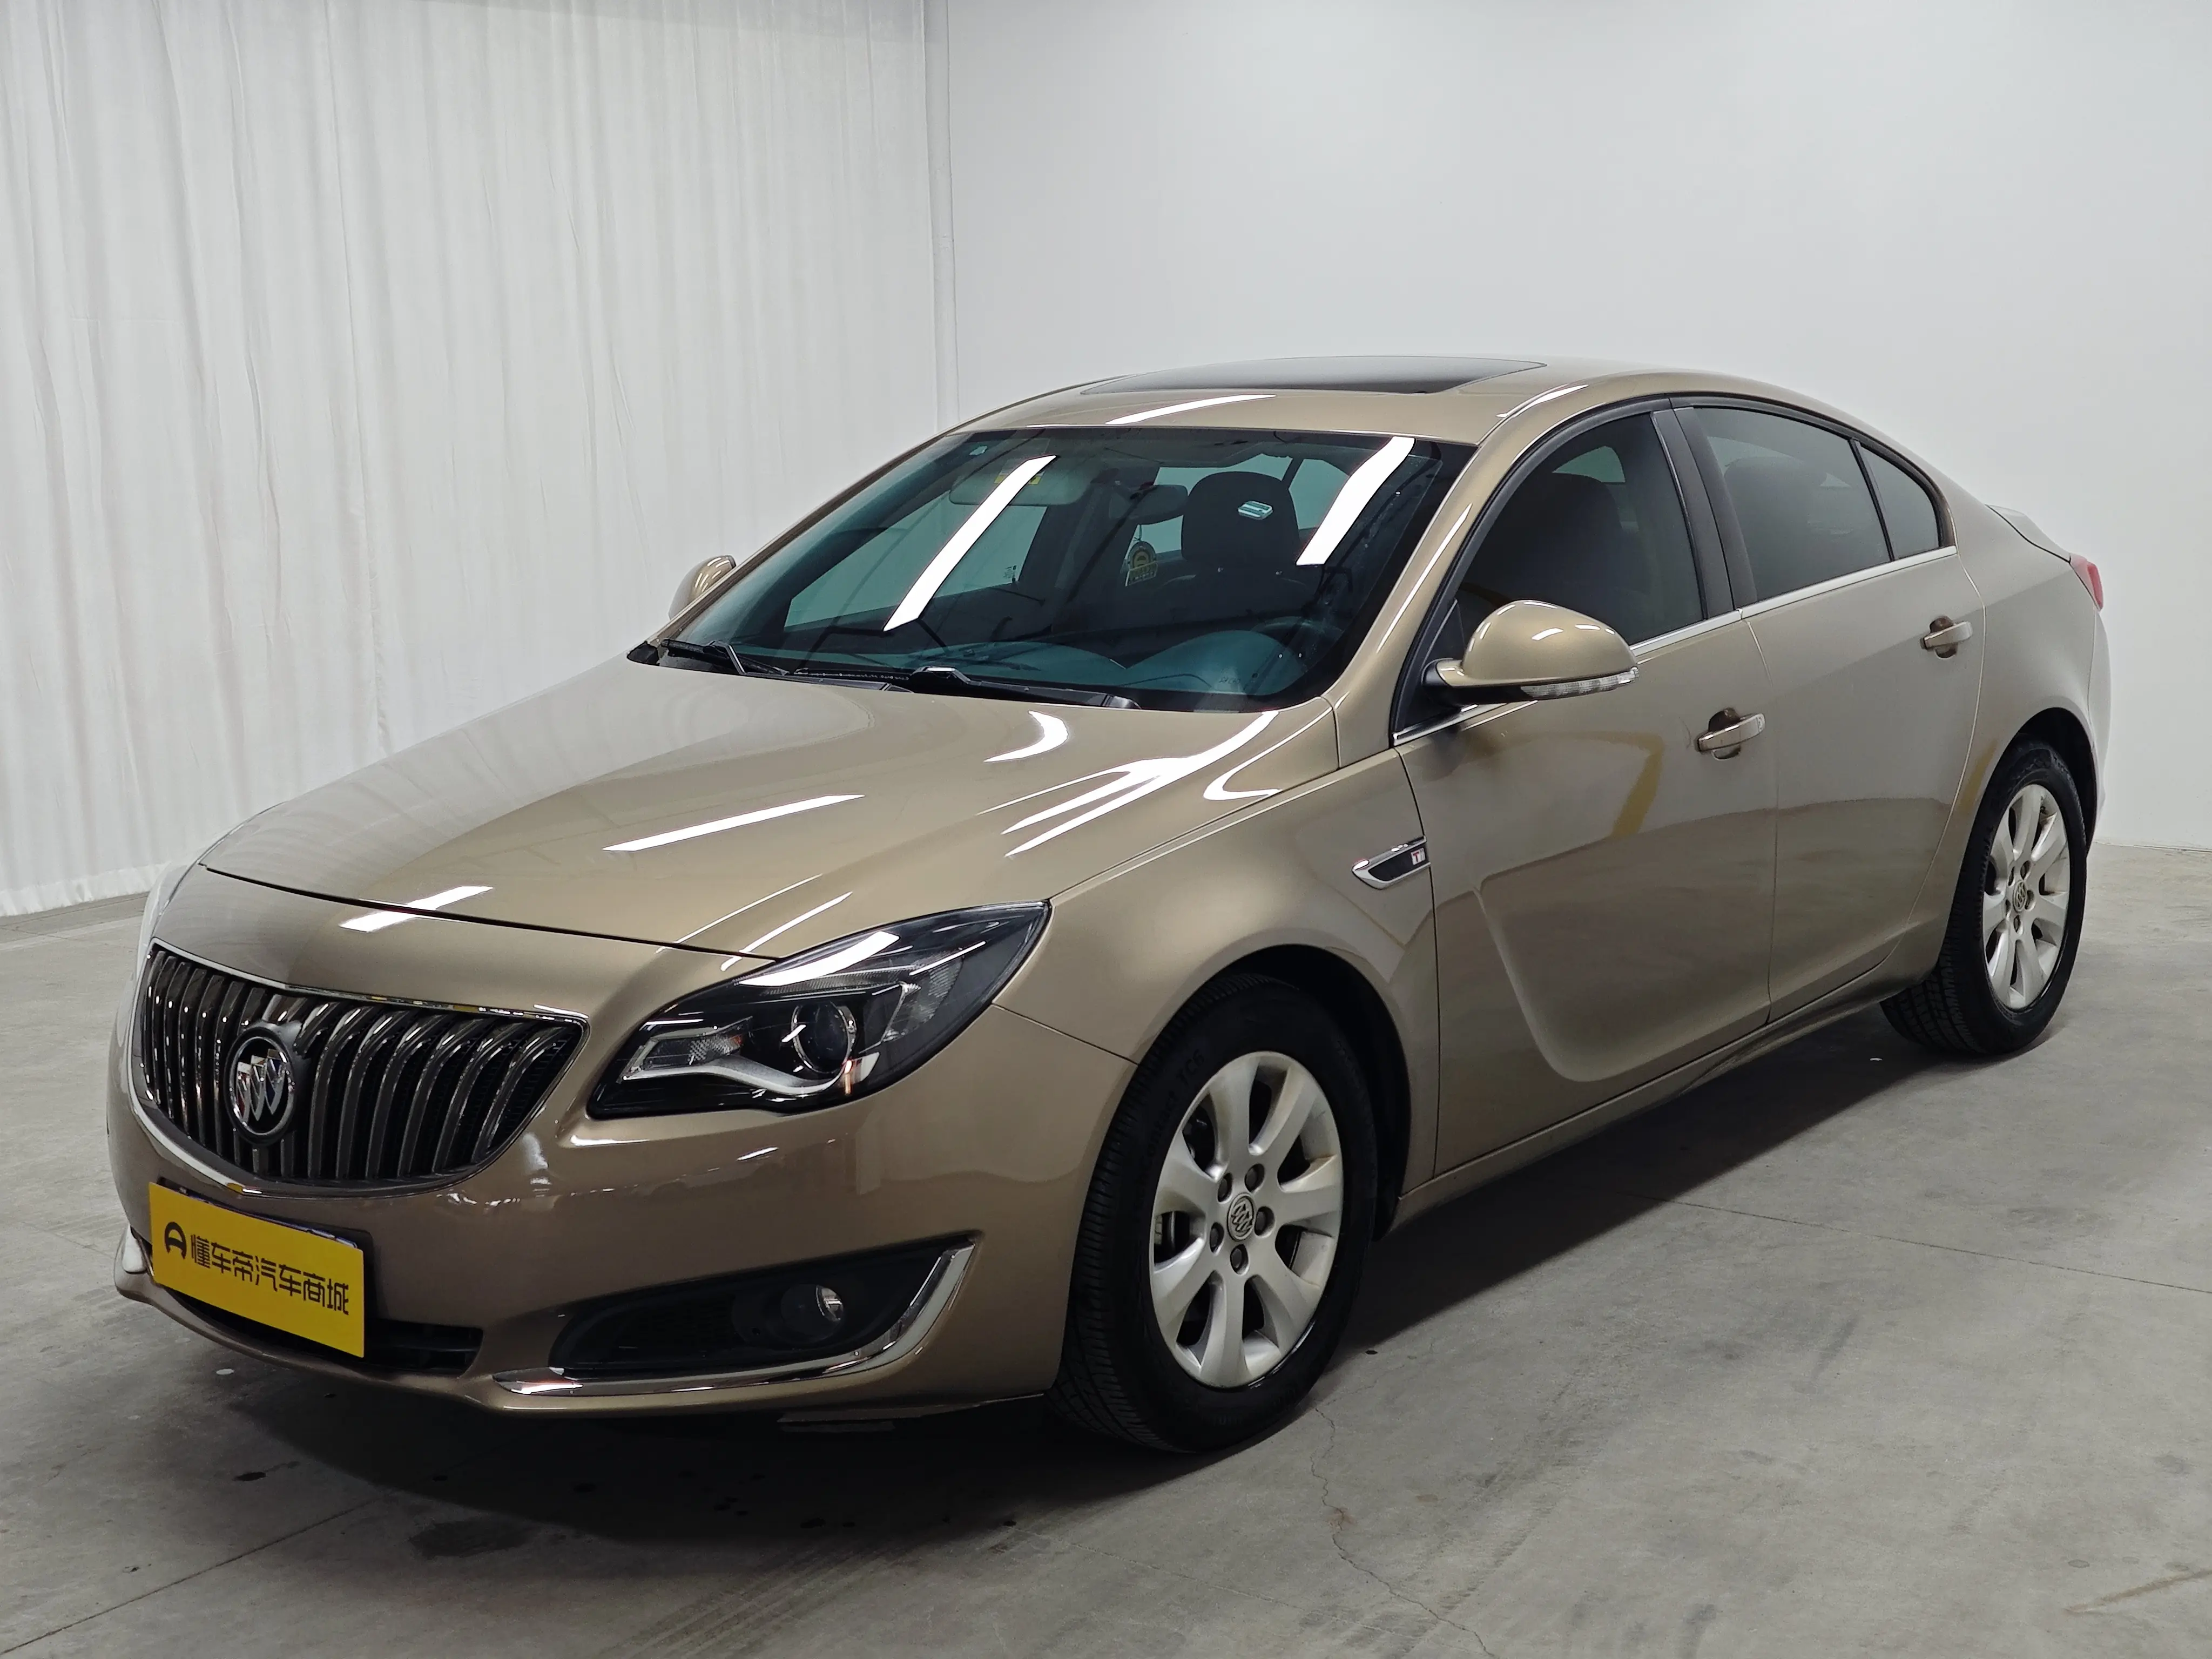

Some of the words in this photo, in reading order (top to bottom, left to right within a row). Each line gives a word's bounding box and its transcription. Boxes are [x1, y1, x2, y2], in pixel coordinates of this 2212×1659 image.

[191, 1235, 349, 1315] 懂车帝汽车商城
